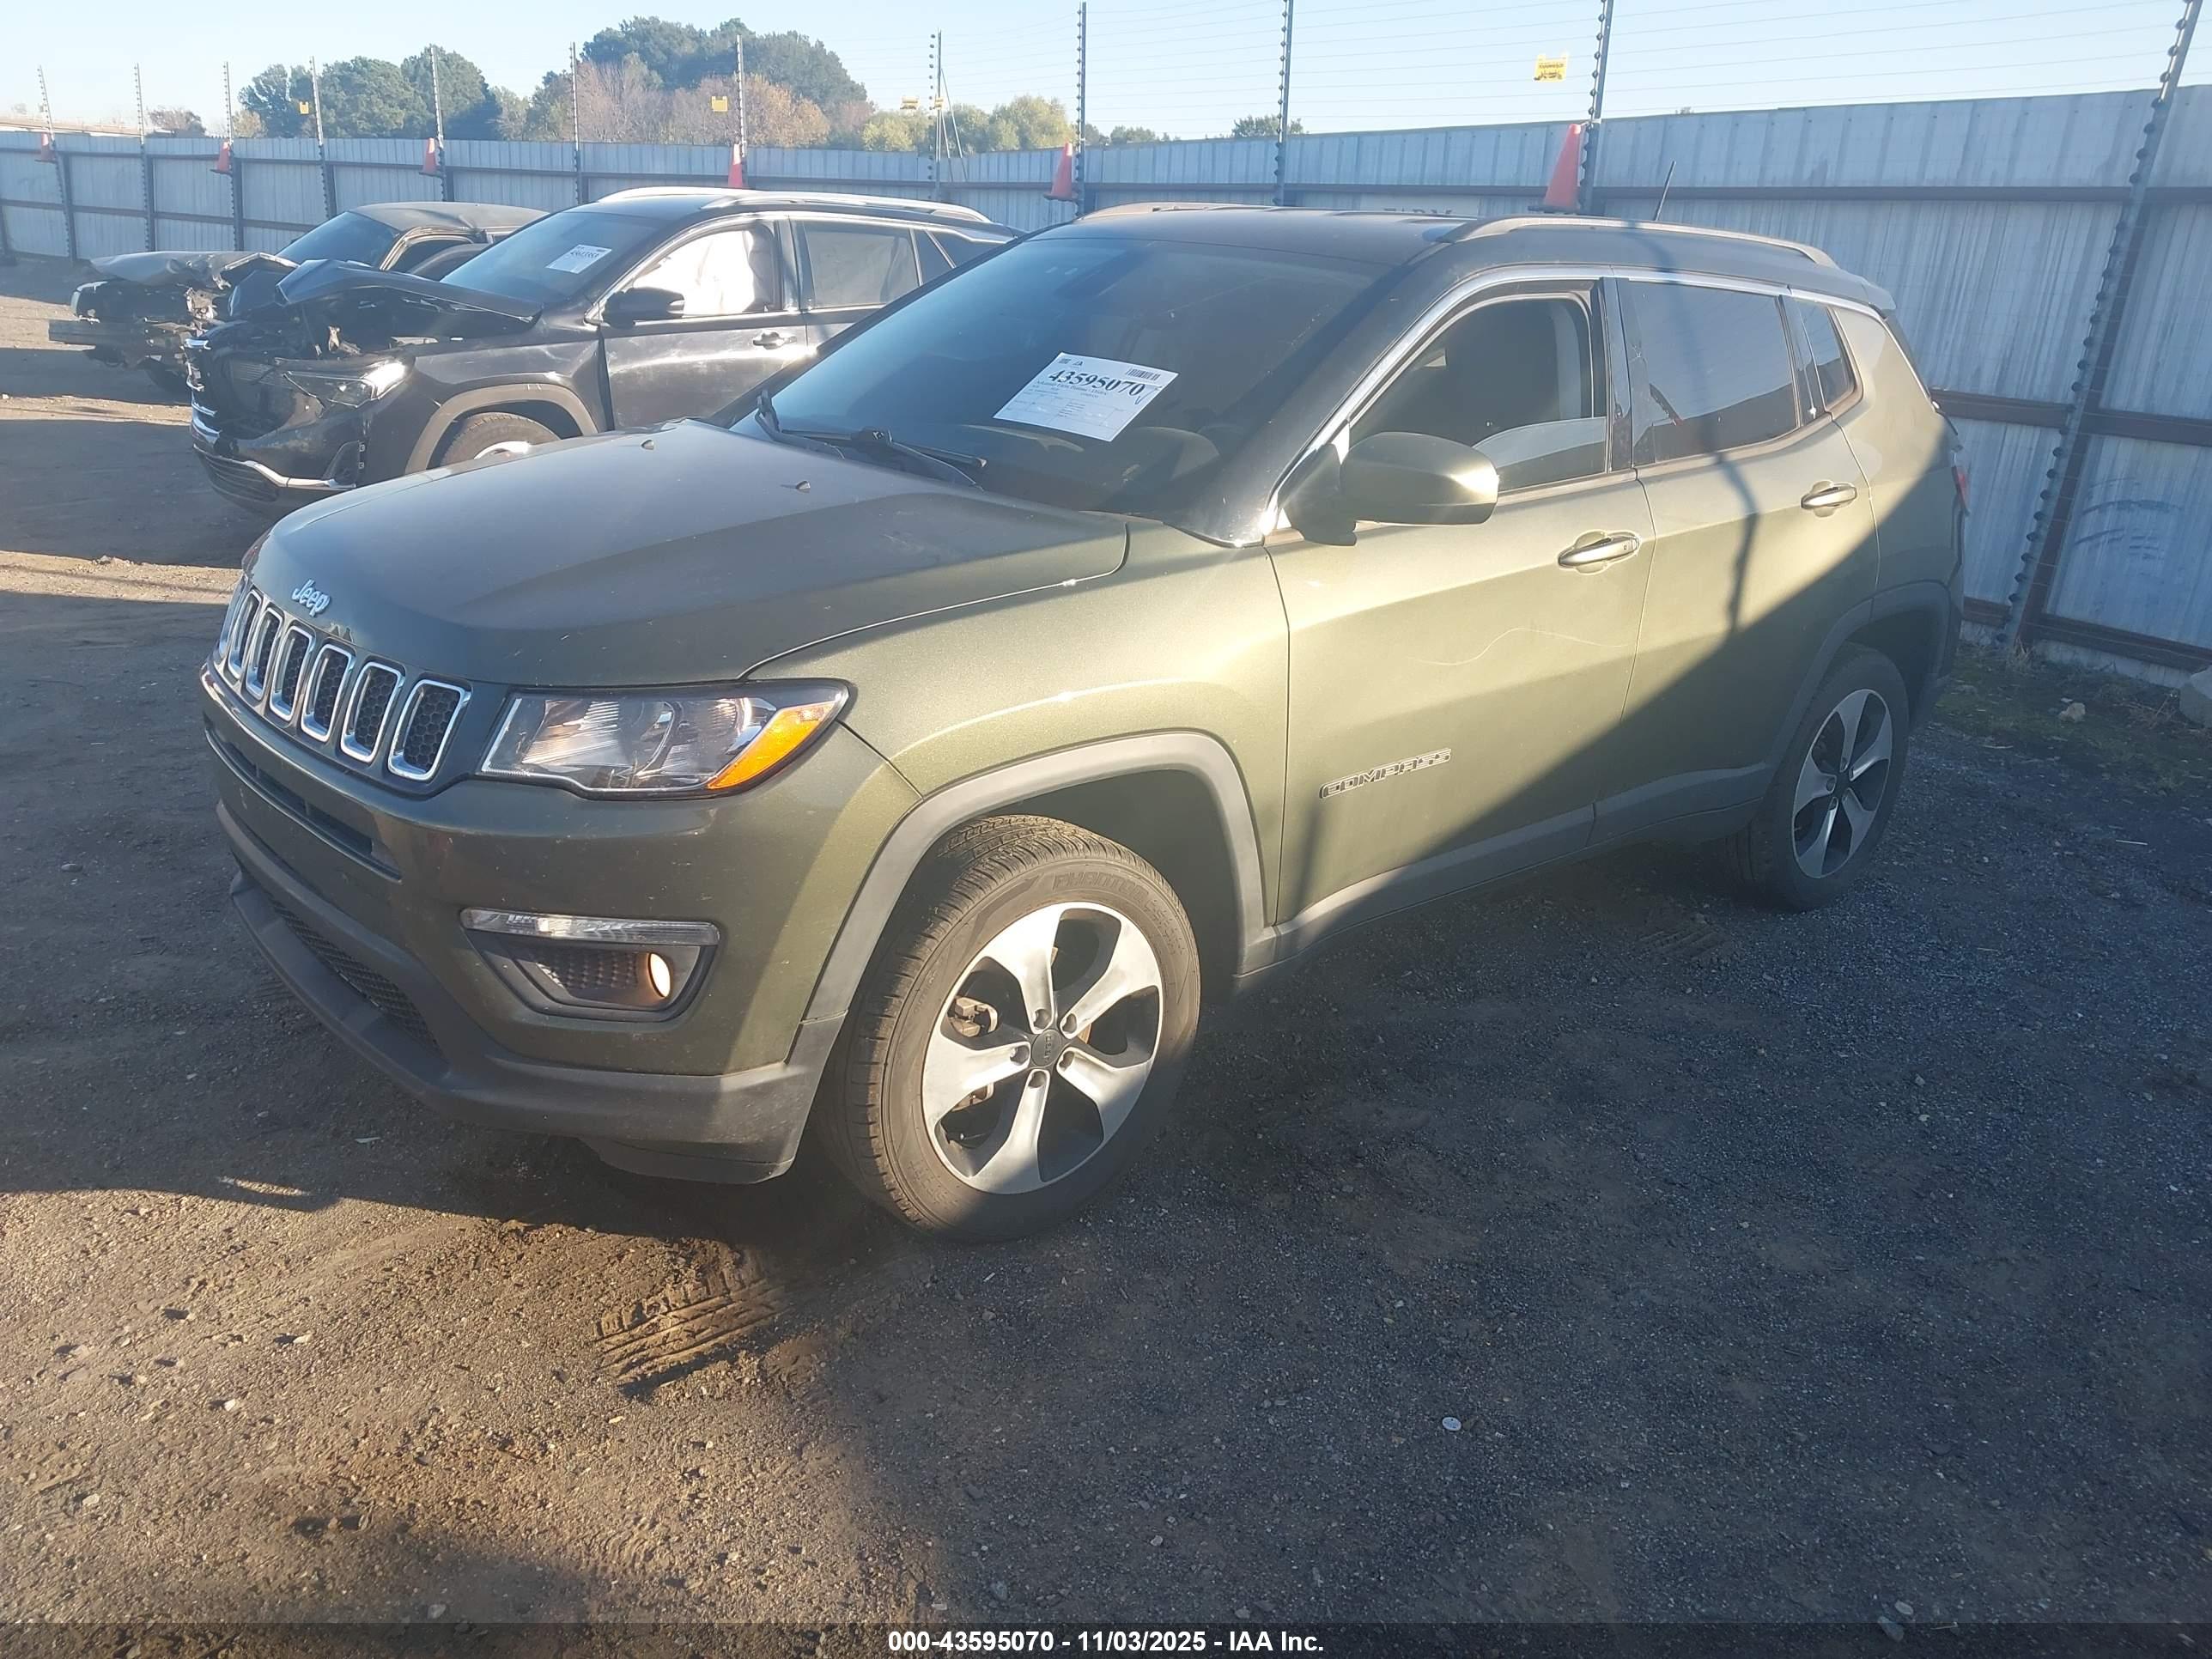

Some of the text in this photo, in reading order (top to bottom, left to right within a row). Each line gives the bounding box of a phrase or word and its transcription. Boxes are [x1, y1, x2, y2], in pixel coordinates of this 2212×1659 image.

[1048, 369, 1146, 397] 43595070
[291, 578, 331, 617] Jeep
[1319, 747, 1452, 799] COMPASS
